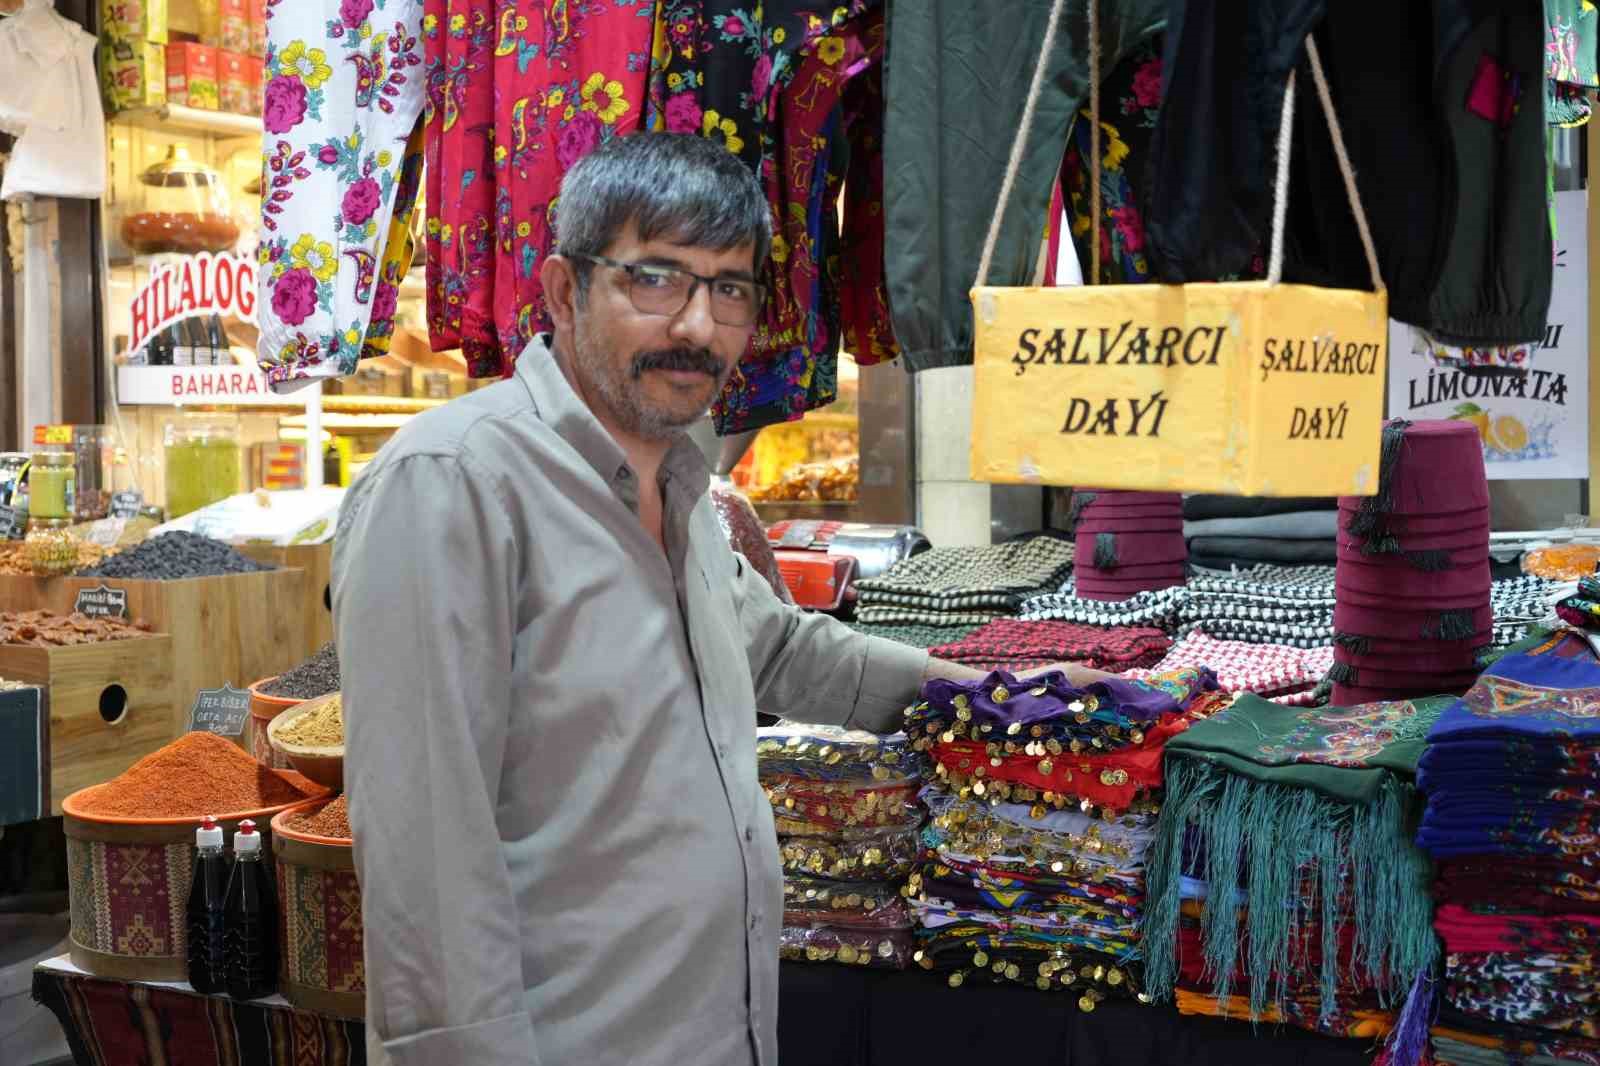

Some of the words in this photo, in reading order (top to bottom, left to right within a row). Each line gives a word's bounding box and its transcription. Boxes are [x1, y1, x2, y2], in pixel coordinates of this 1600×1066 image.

[1012, 320, 1227, 376] ŞALVARCI
[1260, 337, 1380, 382] ŞALVARCI
[1408, 368, 1568, 410] LİMONATA
[1060, 391, 1169, 437] DAYI
[1288, 400, 1349, 440] DAYI
